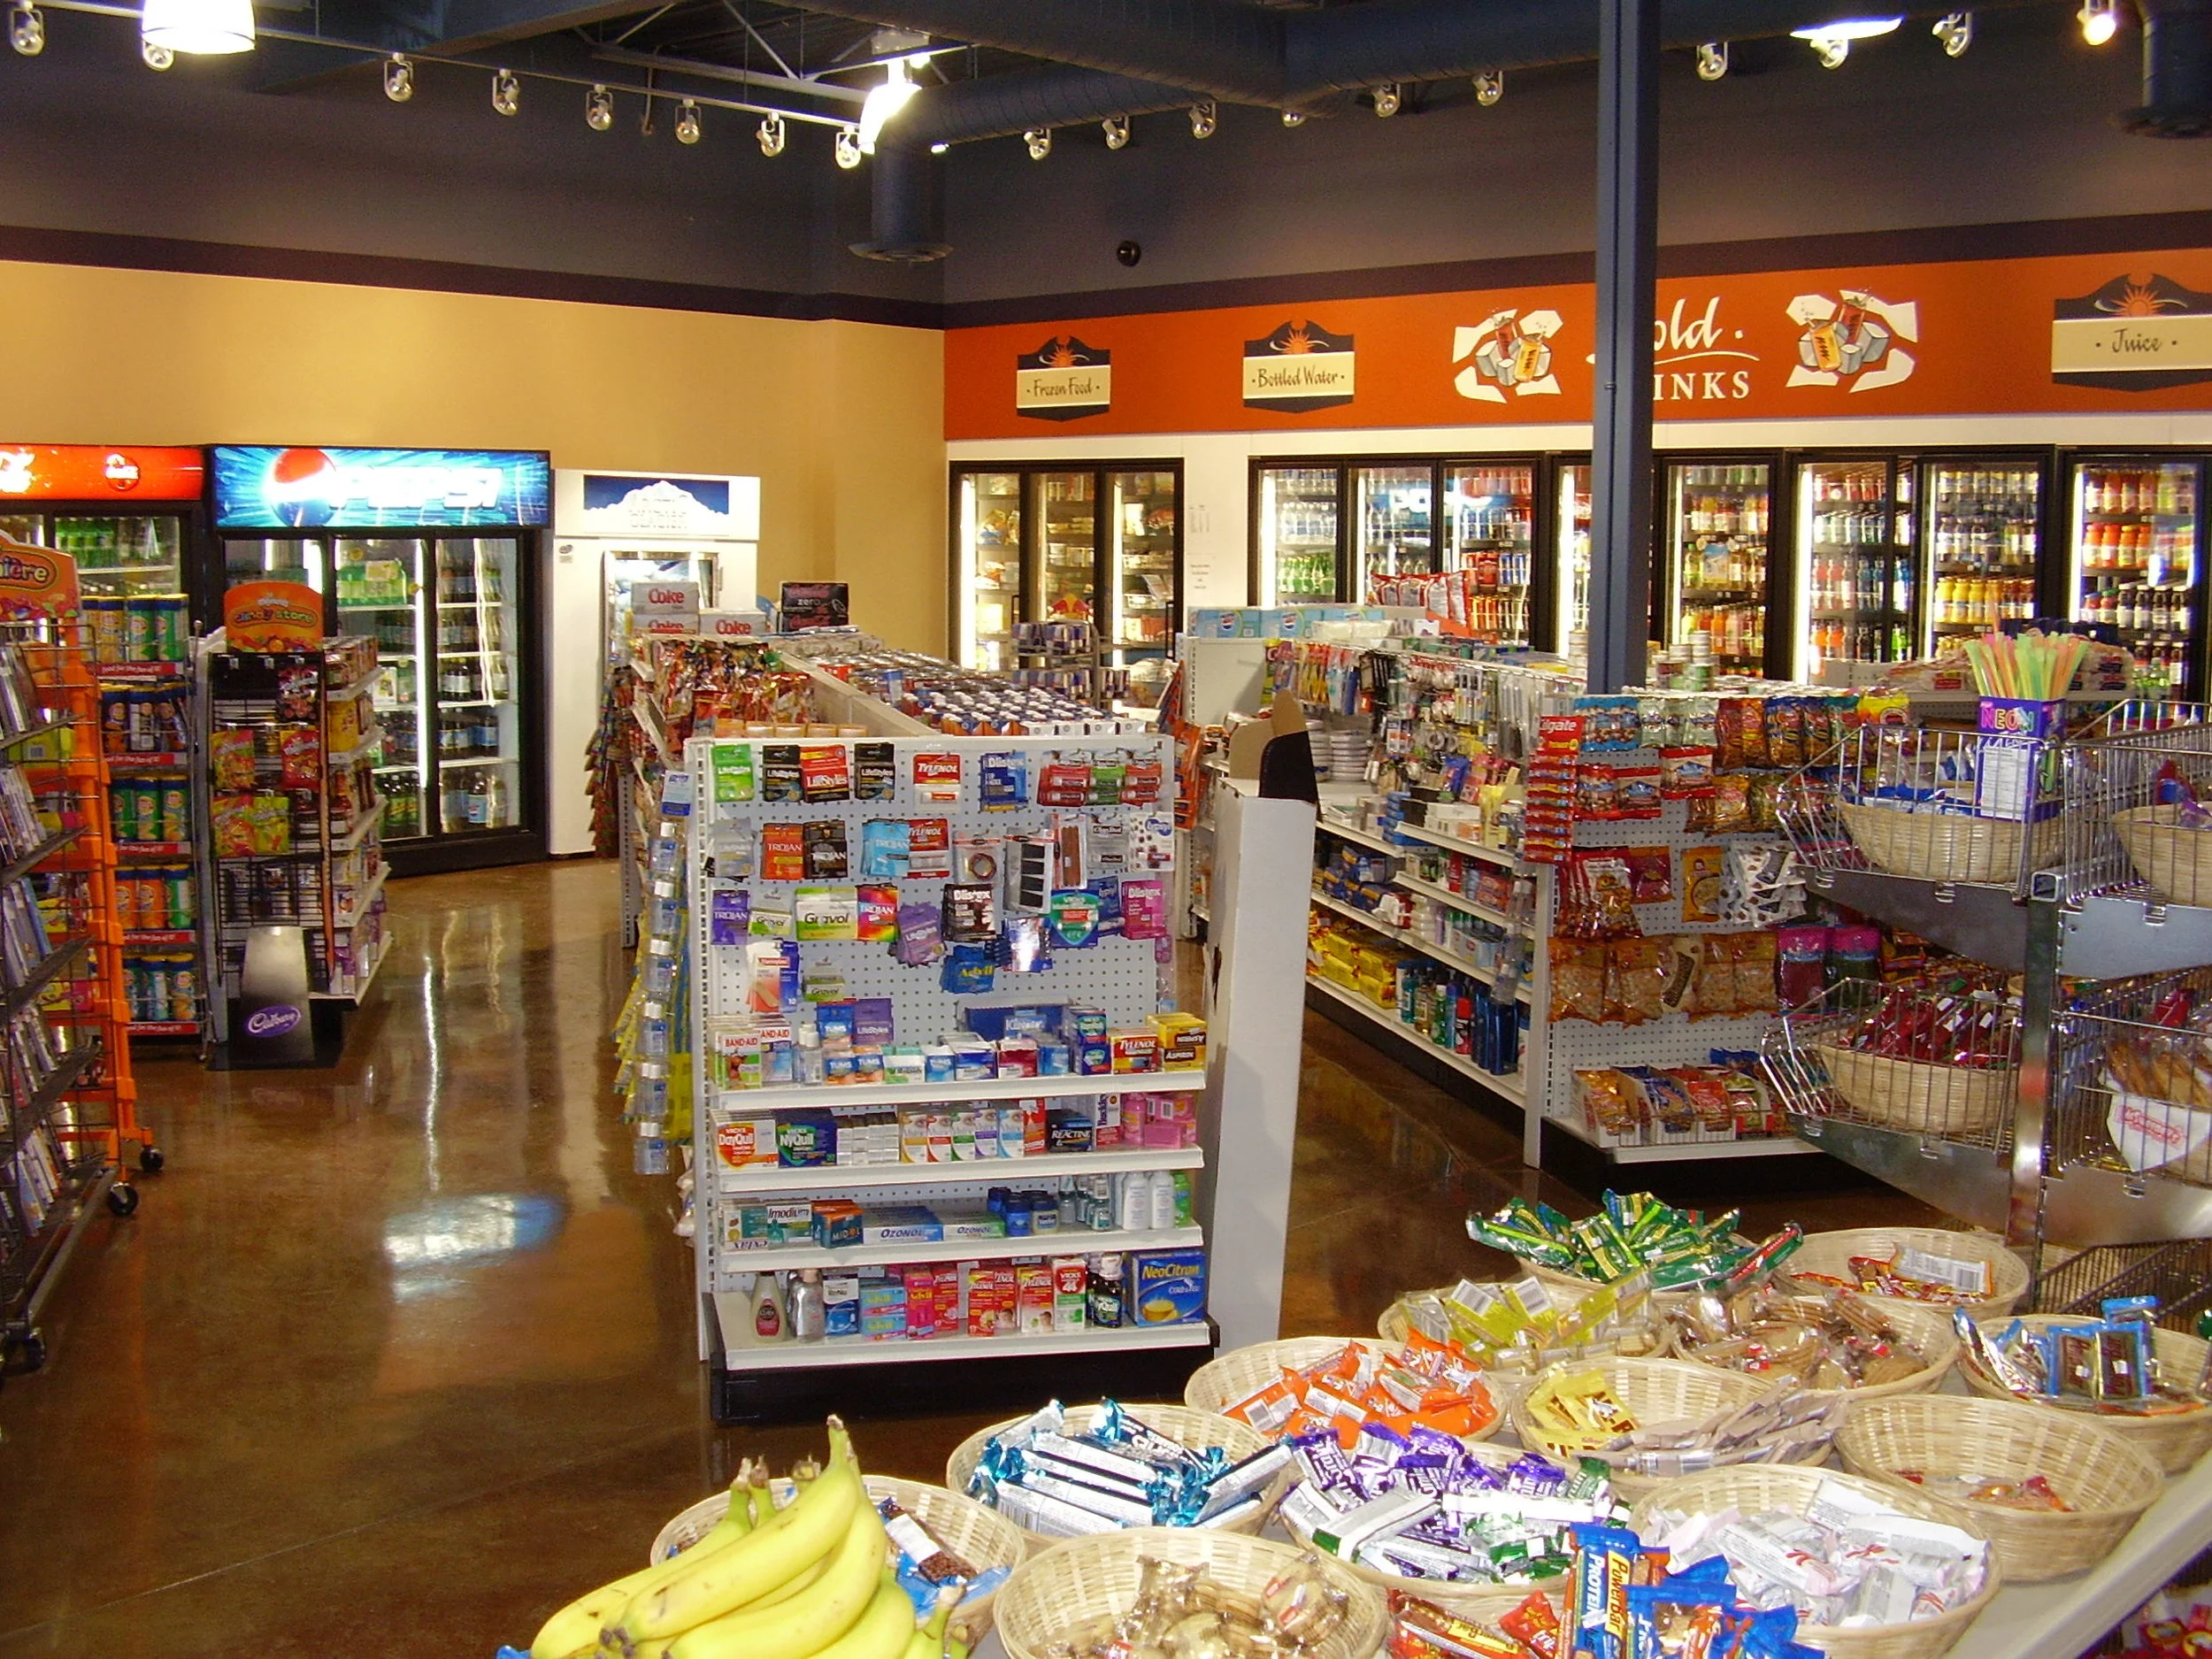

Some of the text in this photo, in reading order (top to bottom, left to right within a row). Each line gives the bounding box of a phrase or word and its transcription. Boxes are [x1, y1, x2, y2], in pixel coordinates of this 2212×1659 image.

[1654, 296, 1723, 350] old
[2112, 328, 2162, 353] Juice
[1257, 365, 1339, 388] Bottled Water
[1033, 376, 1094, 396] Frozen Food
[1653, 371, 1749, 400] INKS
[0, 555, 50, 583] ière
[648, 588, 685, 604] Coke
[234, 607, 312, 623] candy store
[716, 619, 752, 635] Coke
[1540, 718, 1577, 733] olgate
[1980, 707, 2035, 733] NEON
[718, 765, 751, 775] LifeStyles
[767, 769, 801, 779] LifeStyles
[860, 768, 895, 778] LifeStyles
[918, 762, 958, 776] TYLENOL
[806, 774, 849, 788] LifeStyles
[767, 842, 803, 852] TROJAN
[811, 851, 848, 861] TROJAN
[953, 888, 991, 904] Blistex
[1128, 887, 1161, 899] Blistex
[860, 902, 895, 915] TROJAN
[714, 910, 748, 921] TROJAN
[756, 915, 786, 927] Gravol
[803, 912, 849, 925] Gravol
[810, 987, 840, 996] Gravol
[247, 1007, 301, 1034] Cadbury
[758, 1028, 790, 1040] AND-AID
[825, 1025, 847, 1033] TUMS
[725, 1037, 758, 1048] BAND-AID
[1120, 1039, 1156, 1051] TYLENOL
[829, 1061, 851, 1070] TUMS
[857, 1057, 880, 1066] TUMS
[718, 1133, 755, 1147] DayQuil
[779, 1132, 815, 1148] NyQuil
[1051, 1128, 1092, 1140] REACTINE
[768, 1206, 810, 1219] Imodium
[833, 1228, 862, 1240] MIDOL
[880, 1228, 924, 1239] OZONOL
[1609, 1557, 1629, 1630] PowerBar
